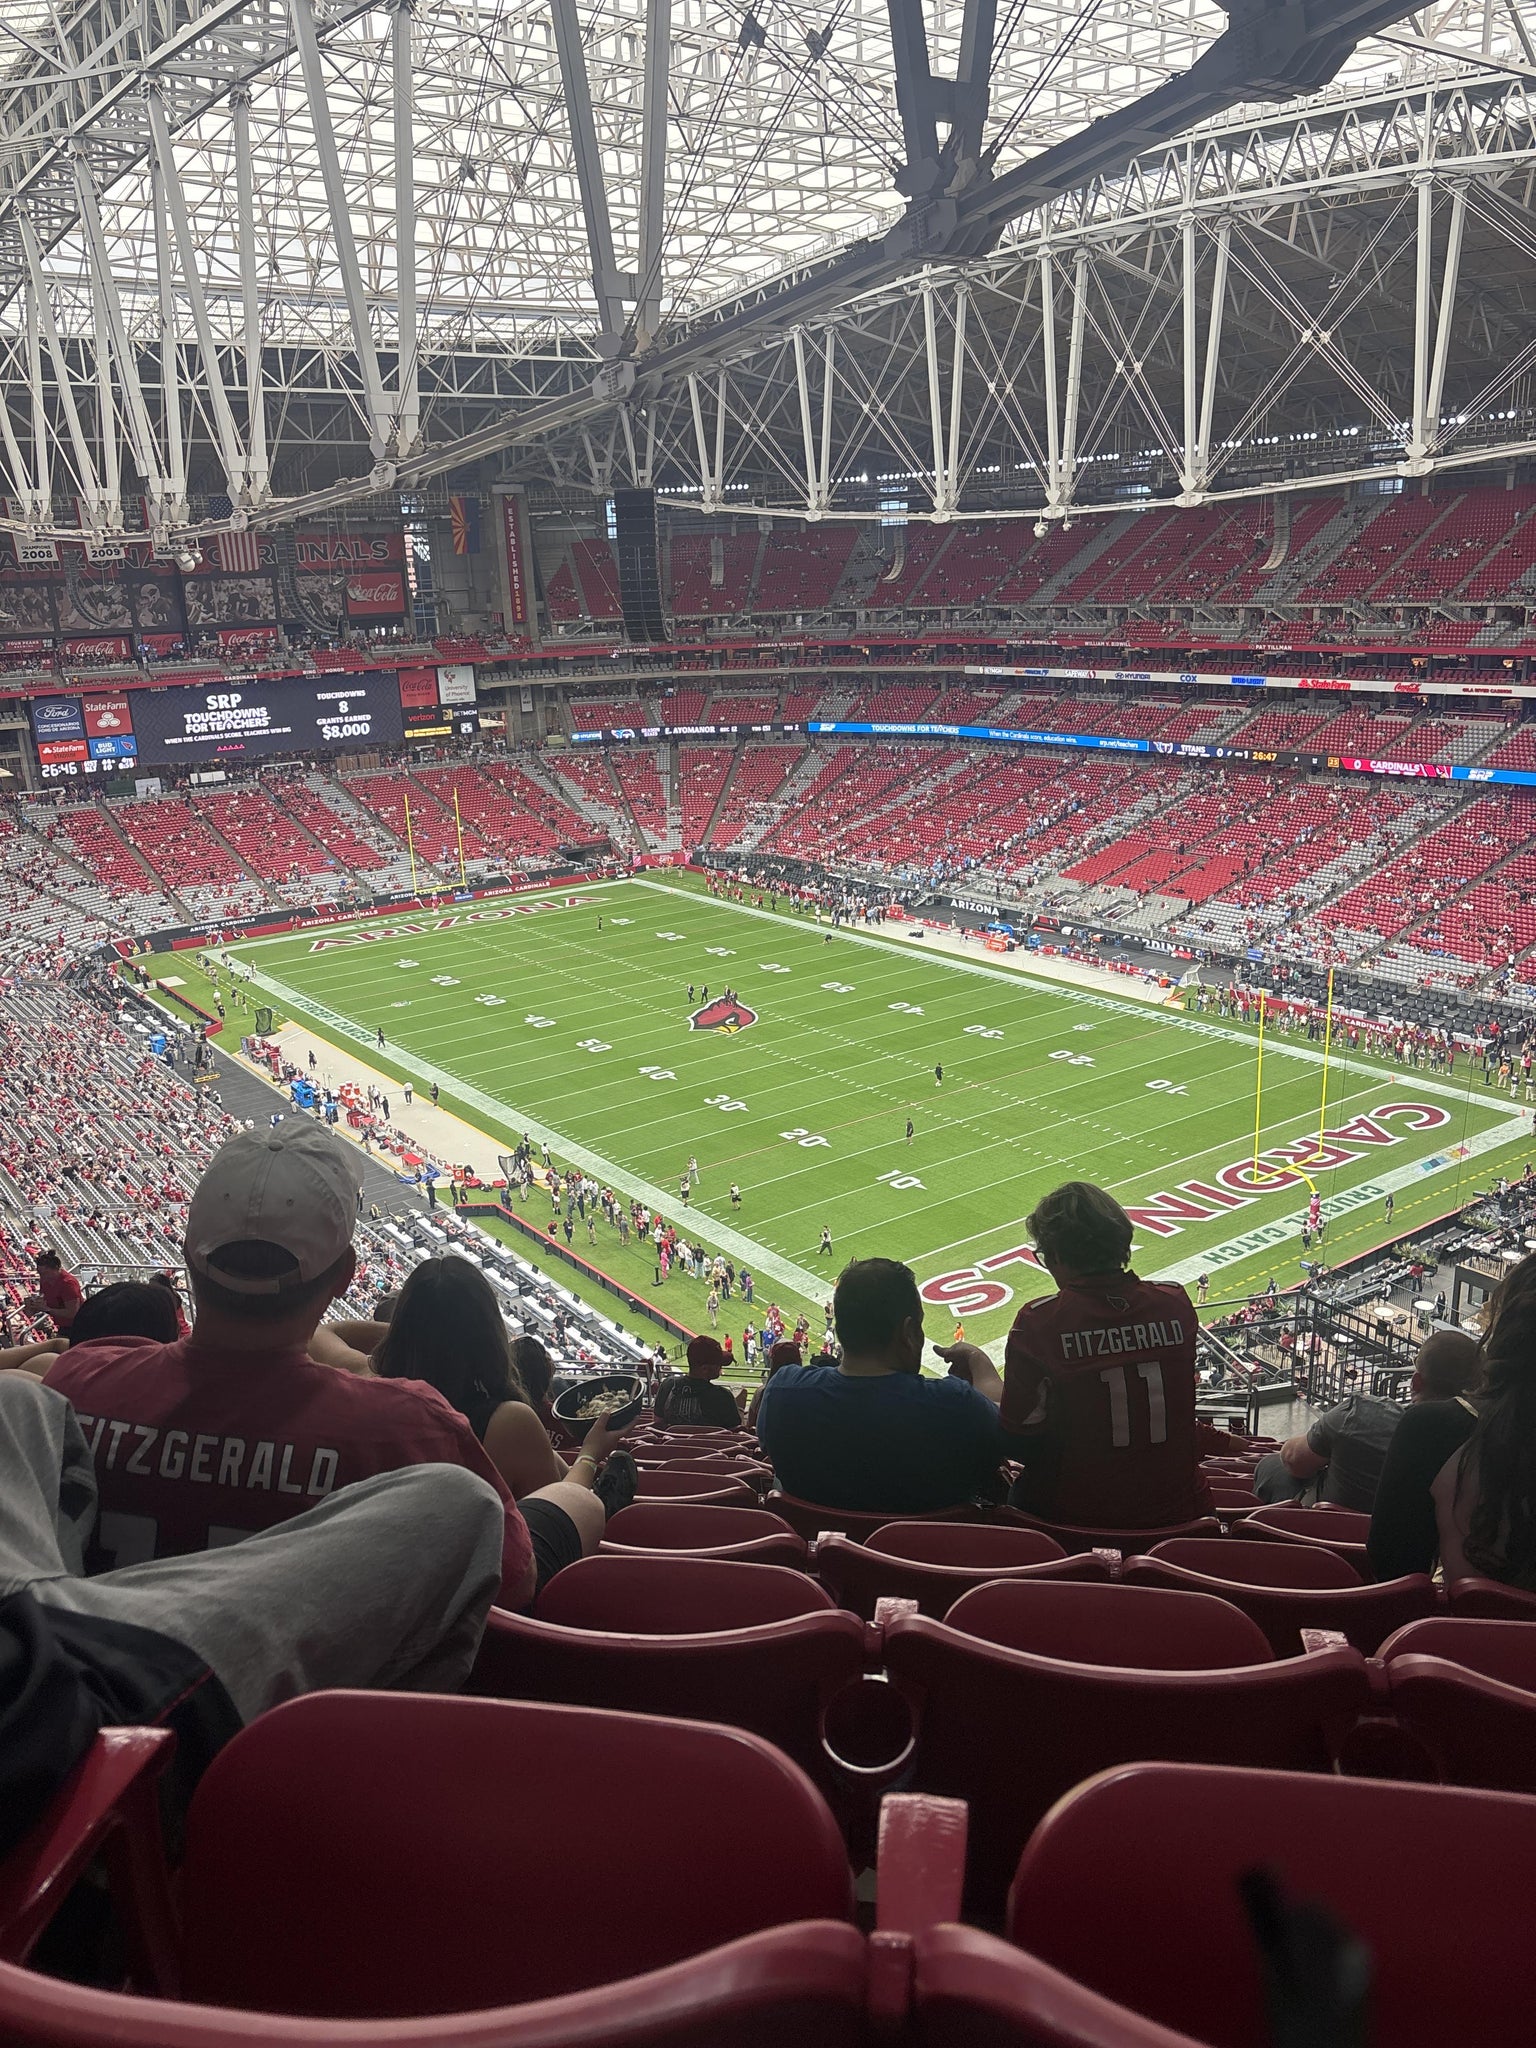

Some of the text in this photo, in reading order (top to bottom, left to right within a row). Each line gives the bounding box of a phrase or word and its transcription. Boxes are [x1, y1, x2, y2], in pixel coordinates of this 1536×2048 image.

[22, 550, 53, 559] 2008
[91, 548, 121, 558] 2009
[206, 541, 389, 567] CRINALS
[507, 508, 520, 590] ESTABLISHED
[514, 591, 522, 620] 1898
[1064, 670, 1088, 678] SAFEWAY
[1180, 674, 1197, 683] COX
[206, 693, 242, 710] SRP
[316, 689, 366, 700] TOUCHDOWNS
[43, 705, 70, 718] Ford
[338, 700, 349, 713] 8
[453, 709, 478, 717] BETMGM
[184, 706, 268, 724] TOUCHDOWNS
[316, 714, 372, 726] GRANTS EARNED
[408, 713, 435, 722] verizon
[185, 722, 209, 734] FOR
[194, 734, 224, 742] CARDINALS
[244, 729, 270, 737] TEACHERS
[322, 722, 371, 741] $8,000
[673, 726, 716, 734] AYOMANOR
[871, 724, 916, 733] TOUCHDOWNS
[1001, 730, 1009, 738] the
[1010, 731, 1030, 739] Cardinals
[1043, 735, 1066, 743] education
[1099, 739, 1138, 749] srp.net/teachers
[95, 746, 116, 754] LIGHT
[1181, 745, 1206, 753] TITANS
[1216, 748, 1223, 757] 0
[1252, 752, 1277, 761] 26:47
[41, 761, 77, 778] 26:46
[1354, 759, 1362, 769] 0
[1370, 760, 1420, 772] CARDINALS
[483, 887, 513, 897] ARIZONA
[515, 881, 551, 892] CARDINALS
[950, 898, 1000, 916] ARIZONA
[189, 917, 256, 933] ARIZONA CARDINALS
[301, 916, 335, 927] ARIZONA
[337, 909, 379, 921] CARNALS
[308, 895, 613, 953] ARIZONA
[394, 958, 420, 969] 10
[429, 974, 461, 987] 20
[820, 981, 856, 993] 50
[474, 993, 507, 1006] 30
[888, 1001, 923, 1016] 40
[1056, 988, 1237, 1040] INTERCEPT CANCER
[287, 996, 377, 1043] INTERCEPT CANCER
[524, 1013, 557, 1029] 40
[1312, 1010, 1393, 1033] RIZON CARDINAL
[963, 1024, 1004, 1040] 30
[575, 1038, 612, 1053] 50
[1048, 1050, 1095, 1067] 20
[638, 1065, 675, 1081] 40
[1145, 1079, 1187, 1096] 10
[703, 1094, 746, 1111] 30
[777, 1128, 829, 1148] 20
[875, 1169, 921, 1190] 10
[920, 1101, 1452, 1320] CARDINLS
[1202, 1227, 1288, 1265] CATCH
[1060, 1319, 1184, 1359] FITZGERALD
[1100, 1361, 1167, 1447] 11
